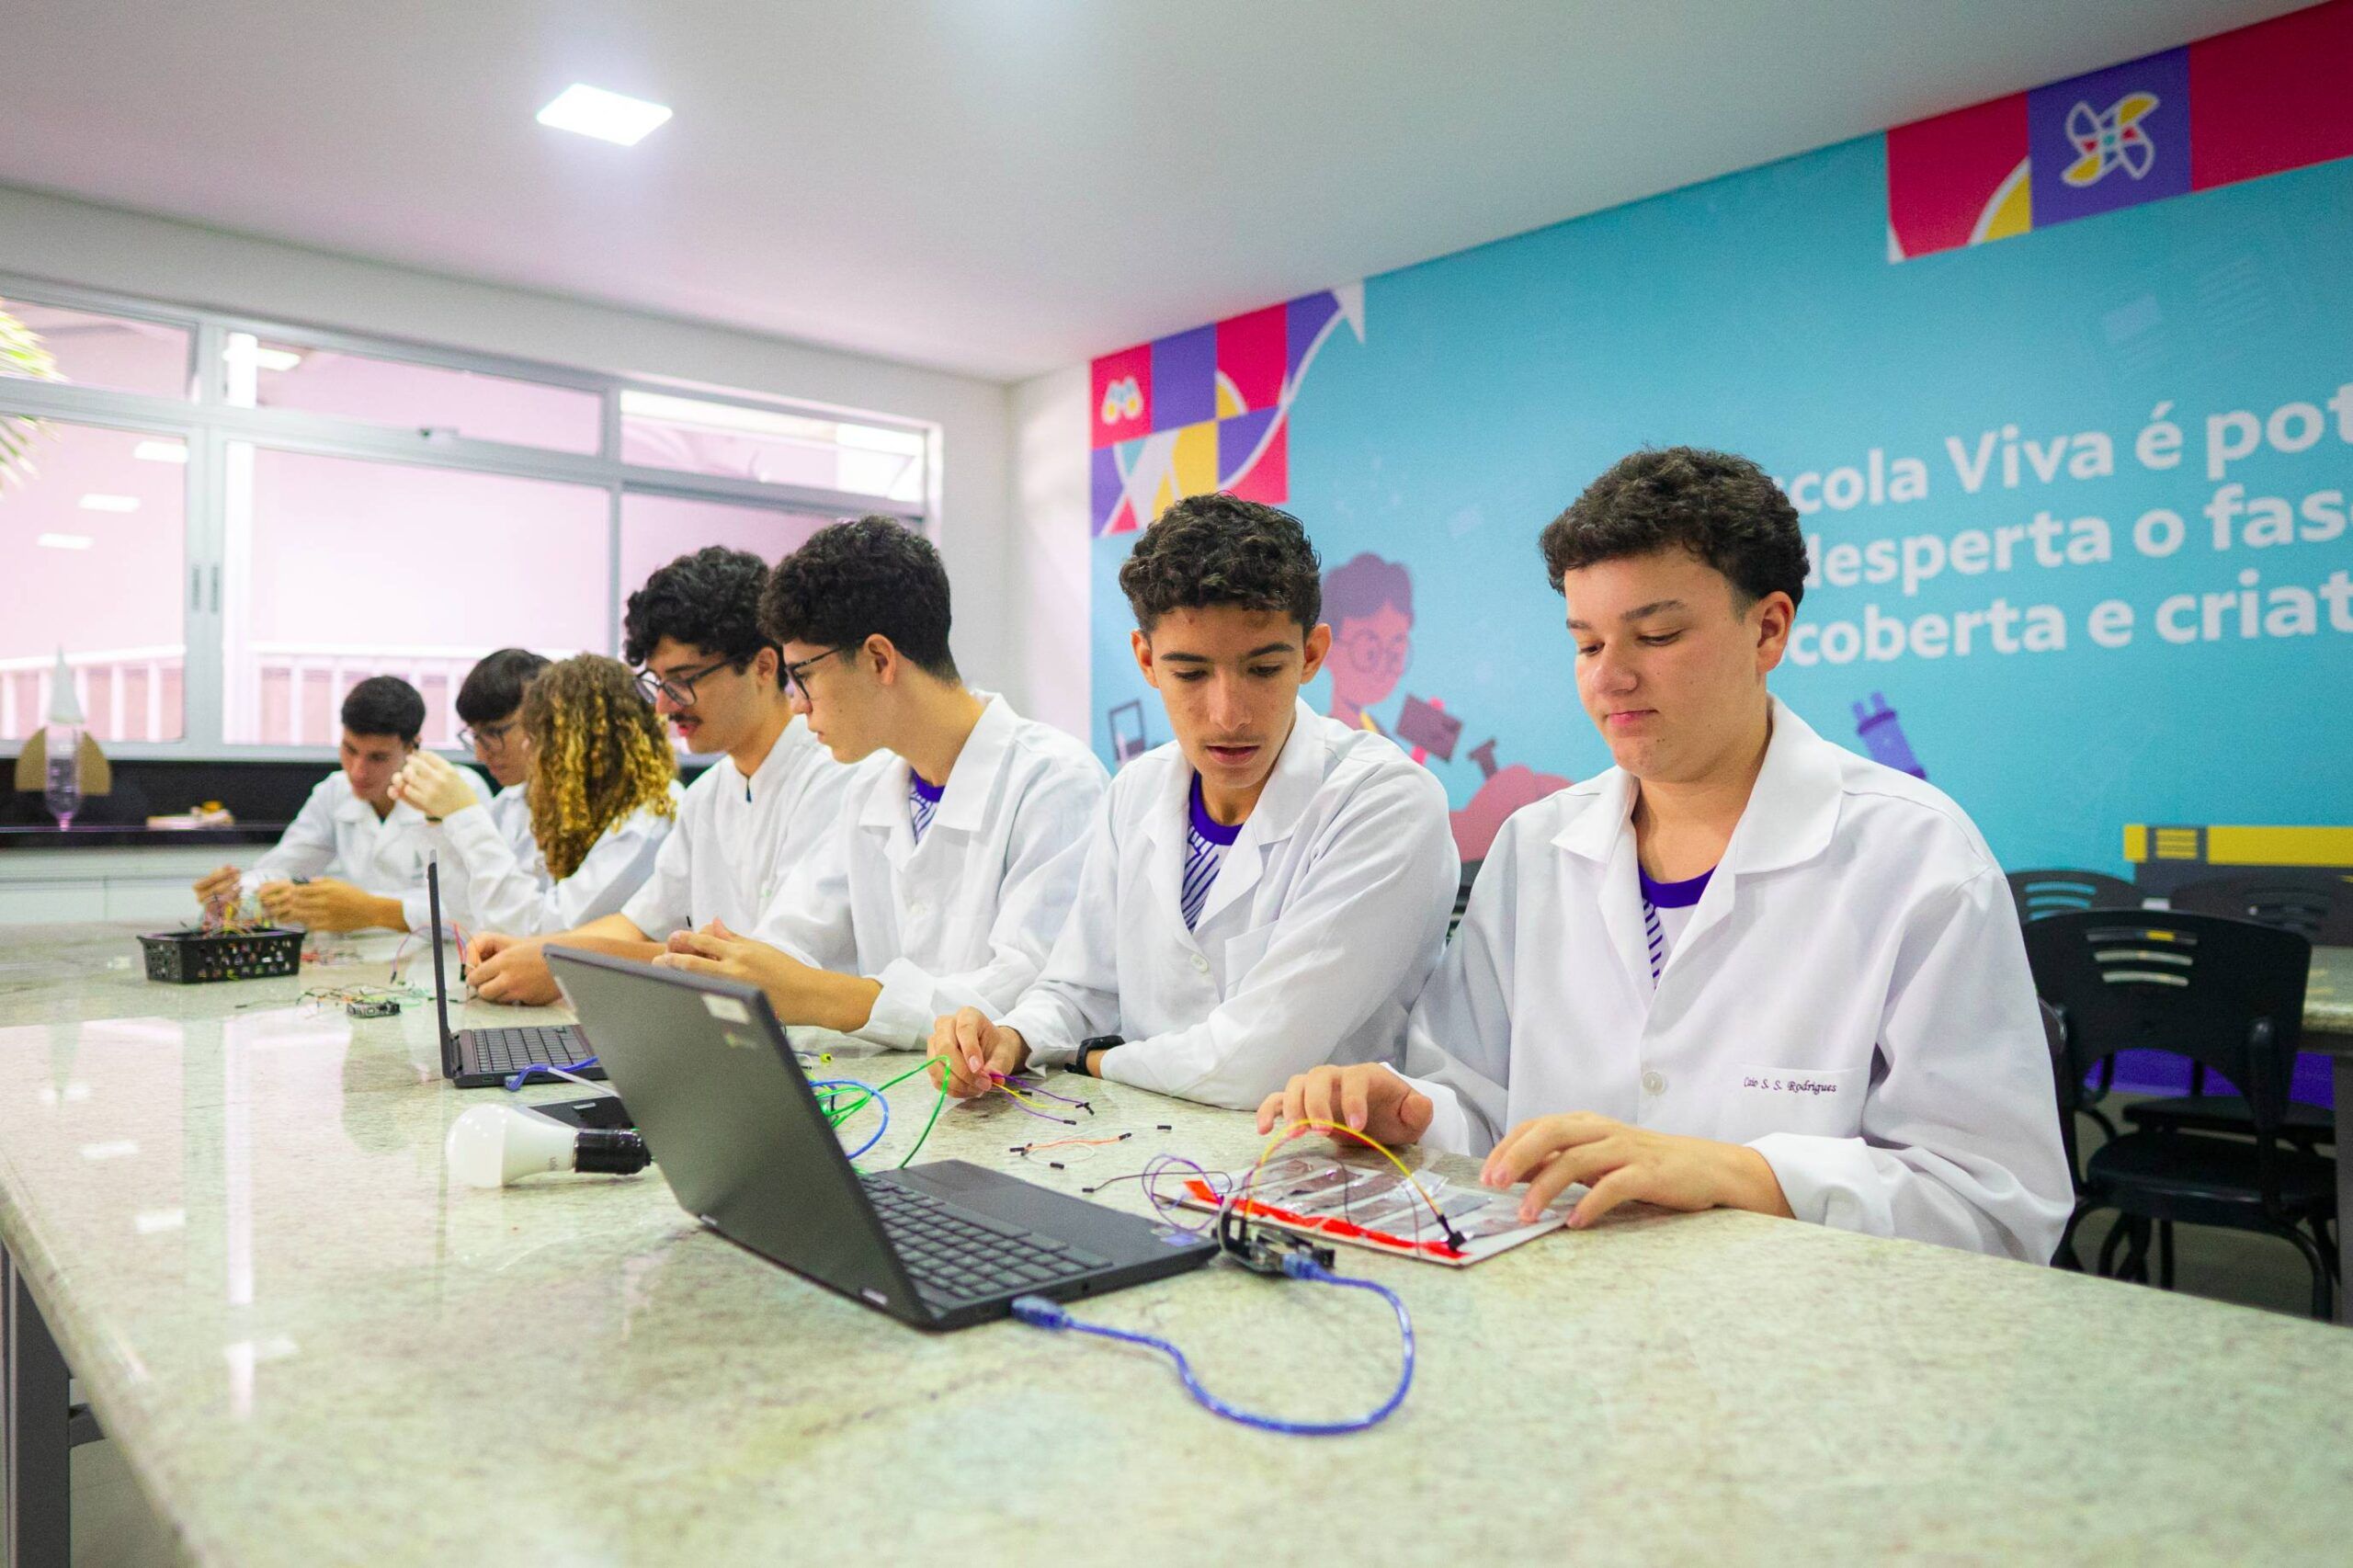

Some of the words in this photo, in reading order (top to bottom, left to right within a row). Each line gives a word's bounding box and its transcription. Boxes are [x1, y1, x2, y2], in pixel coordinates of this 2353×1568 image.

[1774, 449, 1929, 515] cola
[1946, 424, 2115, 494] Viva
[2134, 400, 2183, 470] é
[2133, 508, 2185, 559] o
[2205, 483, 2353, 551] fas
[1783, 597, 2066, 666] coberta
[2087, 599, 2135, 649] e
[1787, 1080, 1837, 1096] Rodrigues
